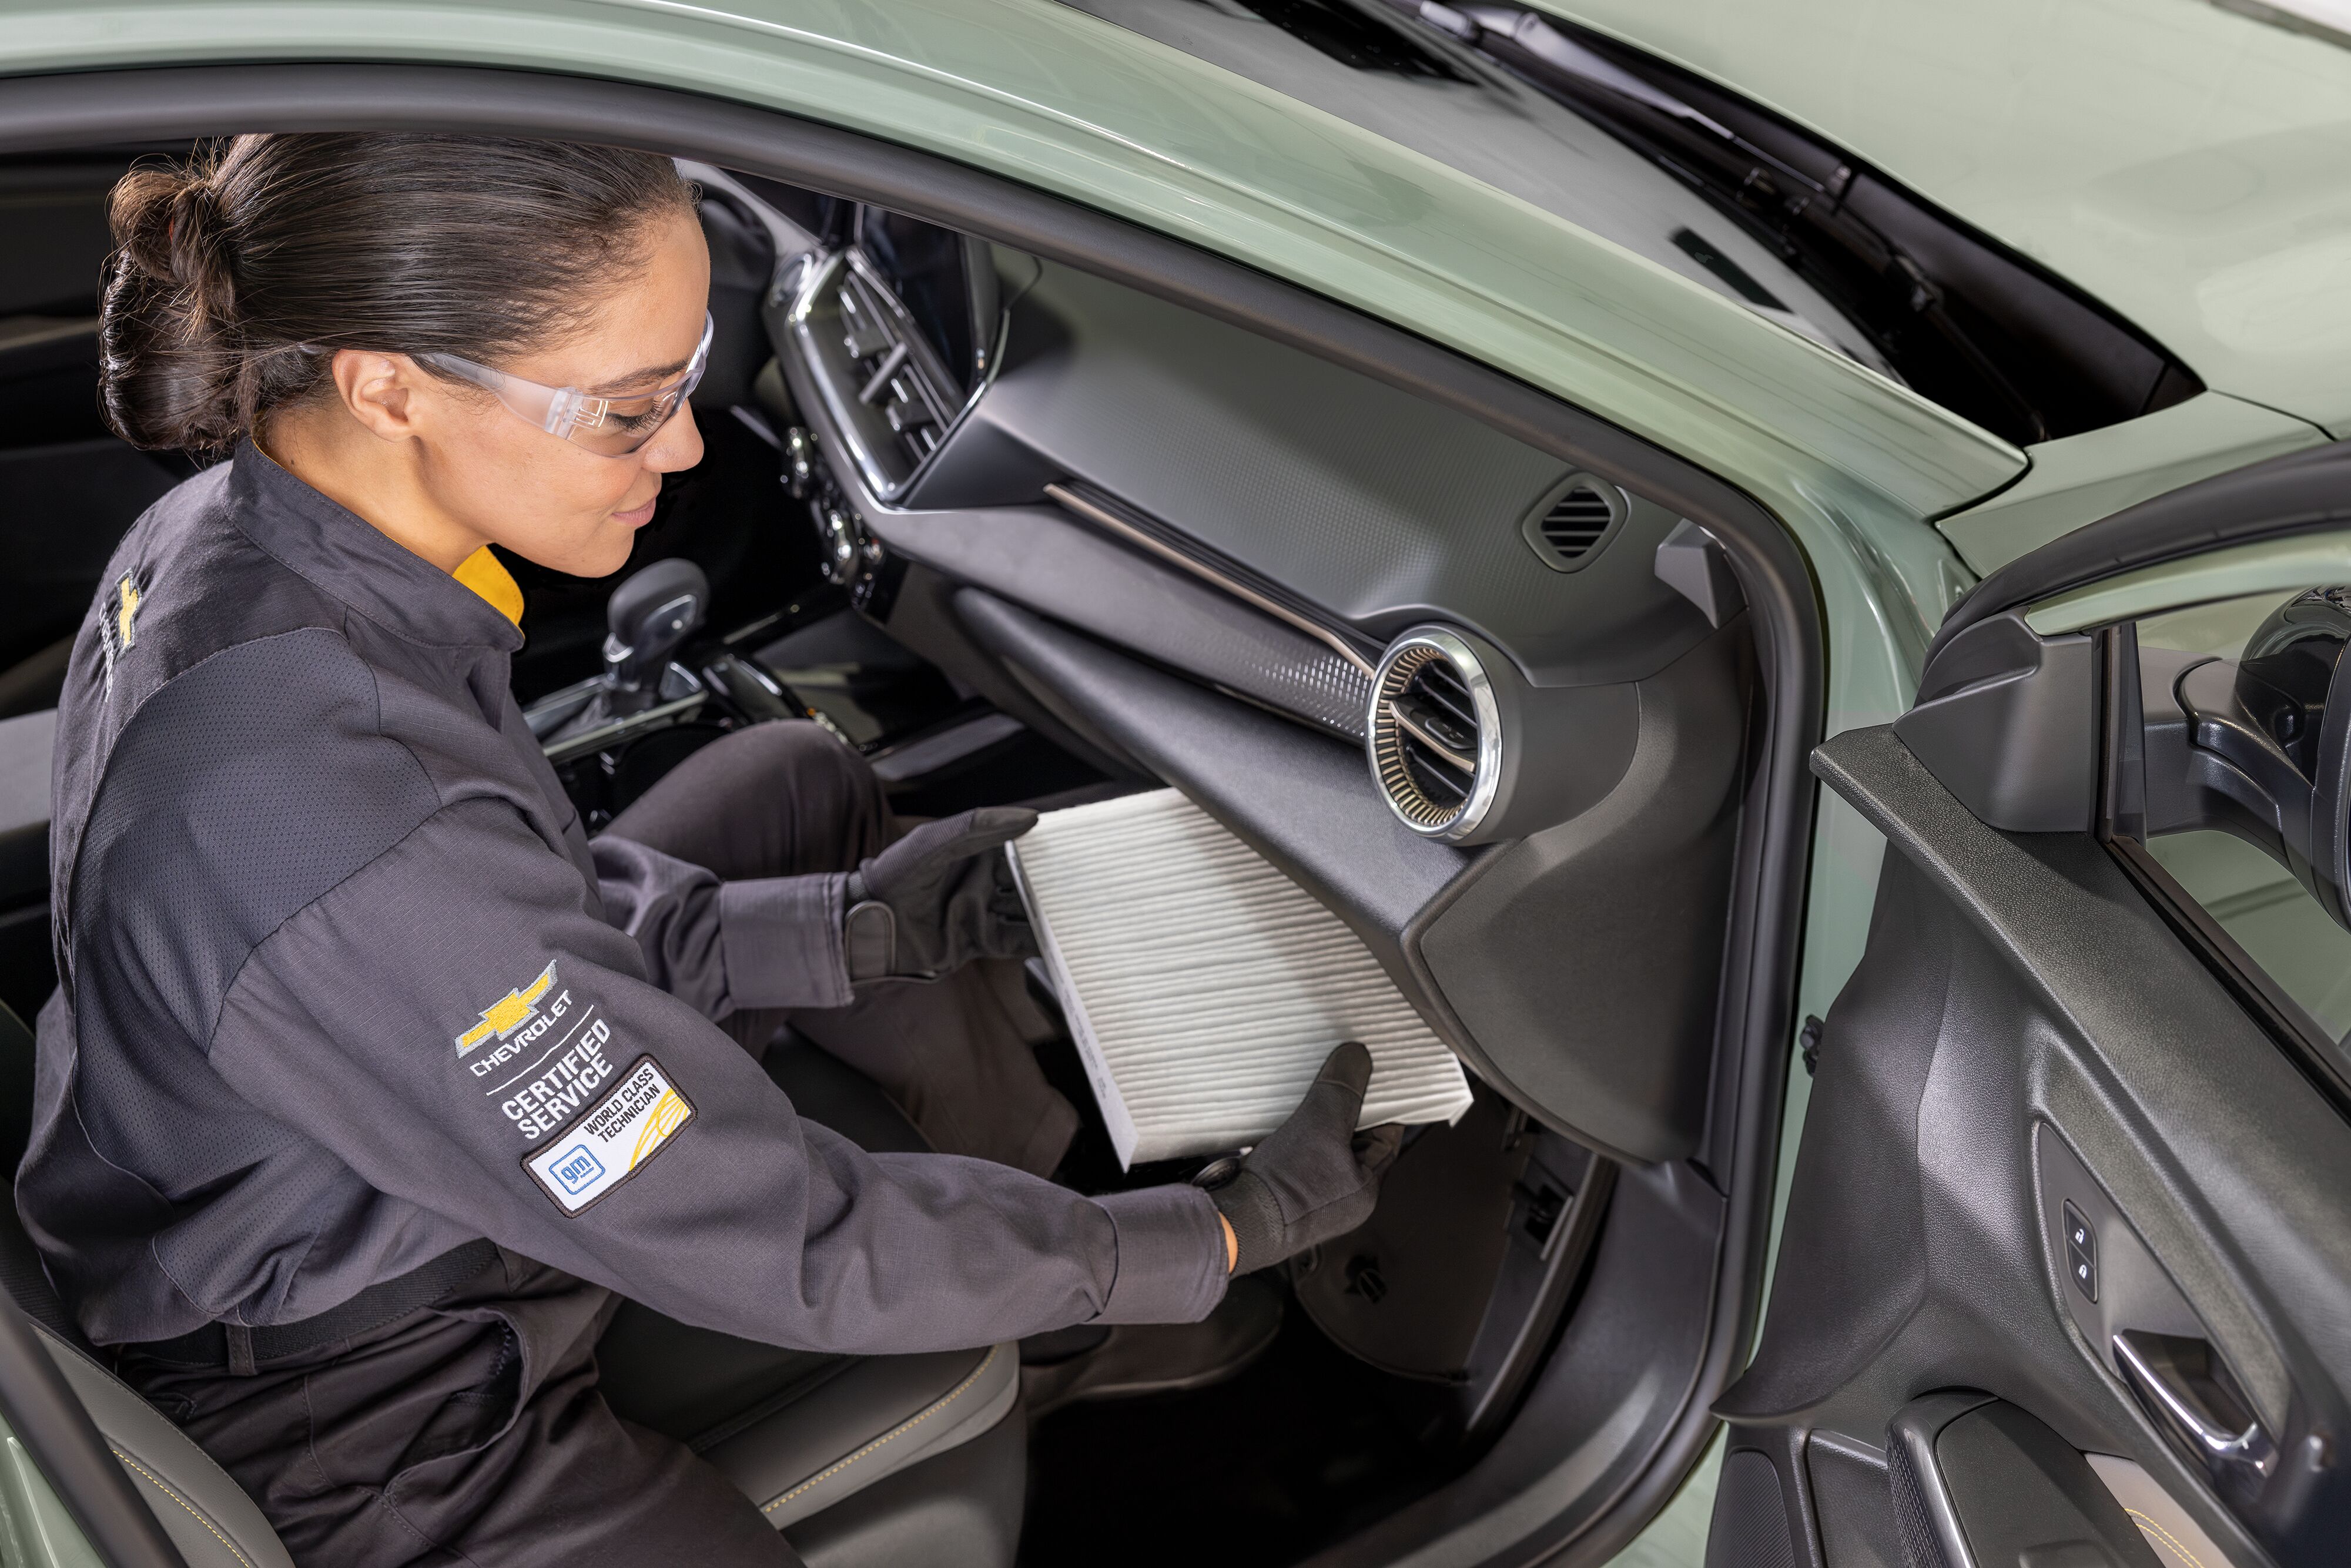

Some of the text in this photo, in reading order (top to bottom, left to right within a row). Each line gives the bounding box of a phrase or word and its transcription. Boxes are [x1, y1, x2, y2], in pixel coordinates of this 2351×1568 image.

[470, 990, 572, 1077] CHEVROLET
[501, 1018, 611, 1121] CERTIFIED
[517, 1053, 614, 1140] SERVICE
[584, 1068, 655, 1135] WORLD CLASS
[598, 1083, 661, 1143] TECHNICIAN
[561, 1154, 594, 1184] gm
